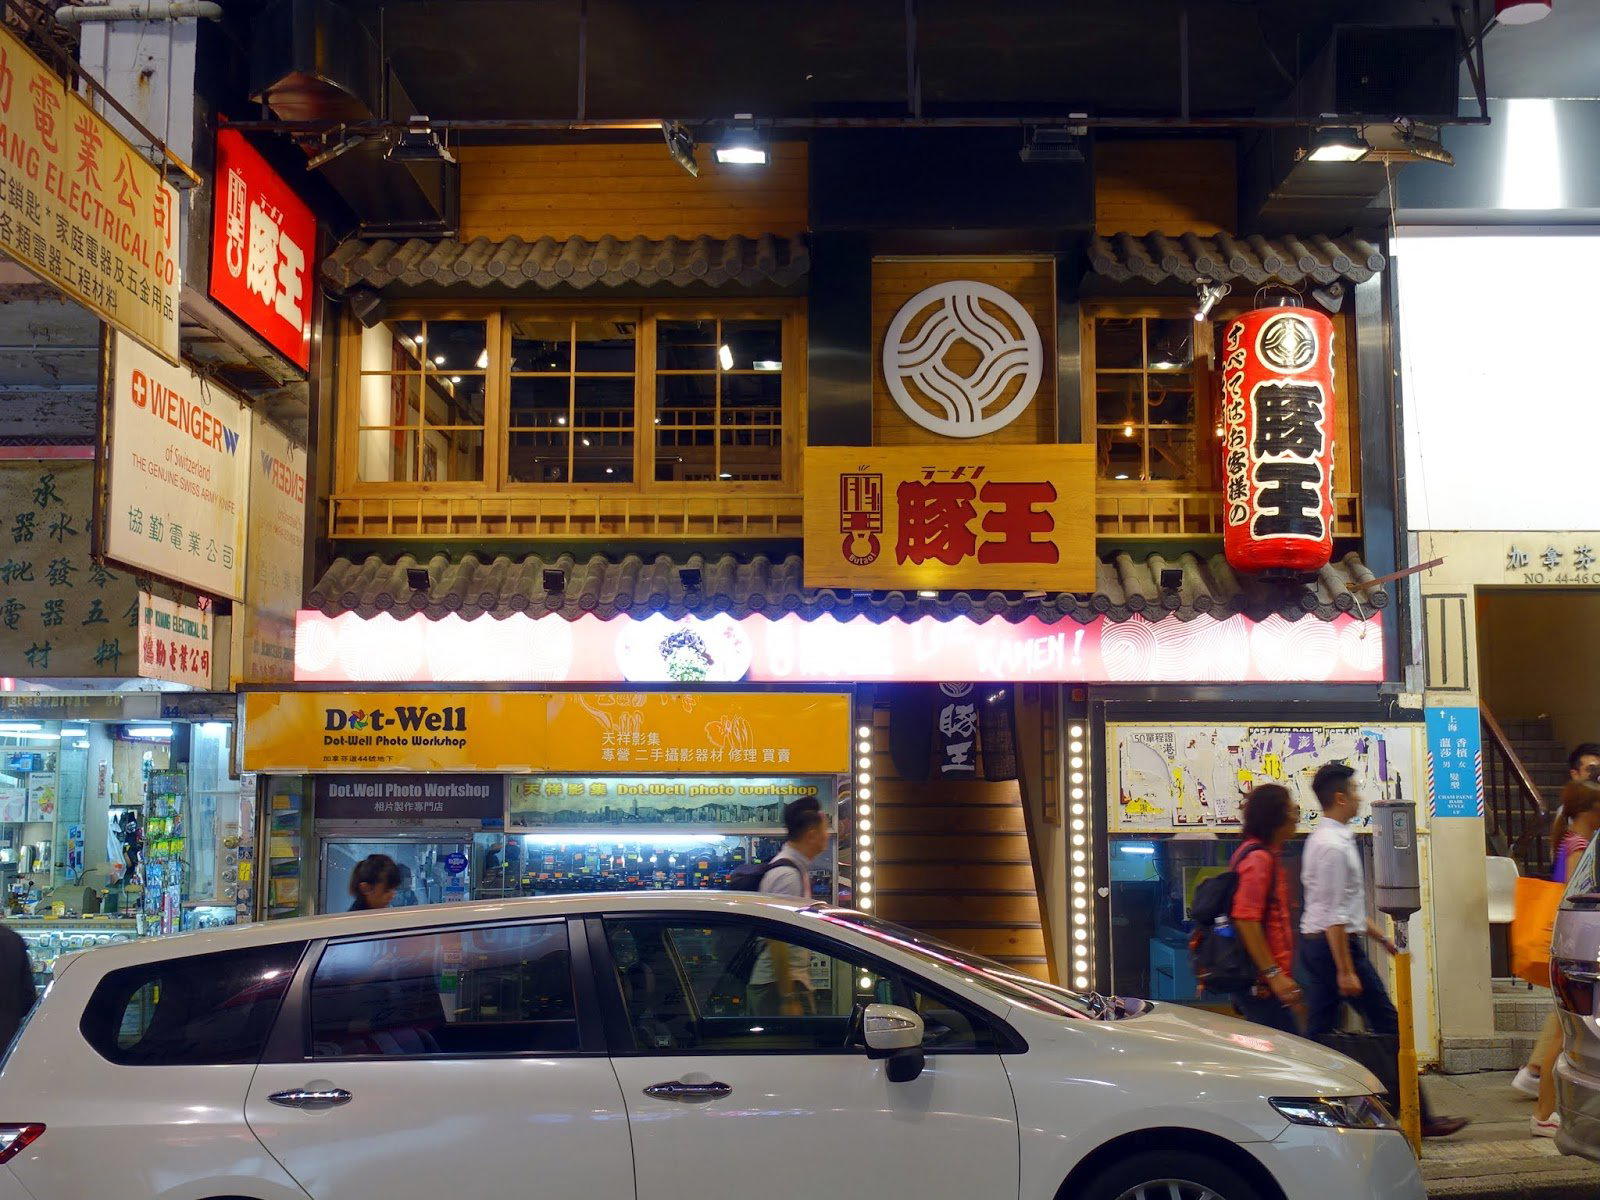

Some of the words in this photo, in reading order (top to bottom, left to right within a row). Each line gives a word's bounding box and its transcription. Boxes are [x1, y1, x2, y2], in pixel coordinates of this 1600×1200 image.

[45, 160, 150, 269] ELECTRICAL
[148, 378, 223, 453] WENGER
[1227, 322, 1250, 525] すべてはお客様の
[1251, 381, 1325, 540] 豚王
[132, 453, 147, 473] THE
[148, 460, 180, 487] GENUINE
[180, 472, 201, 498] SWISS
[921, 465, 986, 480] ラーメン
[895, 480, 1060, 566] 豚王
[128, 505, 235, 570] 協勤電業公司
[1555, 573, 1590, 584] 44-46
[323, 735, 373, 746] Dot-Well
[376, 735, 409, 746] Photo
[411, 735, 467, 749] Workshop
[602, 732, 661, 747] 天祥影集
[729, 748, 757, 763] 修理
[329, 783, 383, 797] Dot.Well
[385, 783, 423, 797] Photo
[424, 783, 490, 799] Workshop
[522, 782, 607, 797] 天祥影集
[617, 783, 686, 796] Dot.Well
[690, 783, 735, 798] photo
[739, 783, 818, 798] workshop
[374, 801, 444, 812] 相片製作專門店
